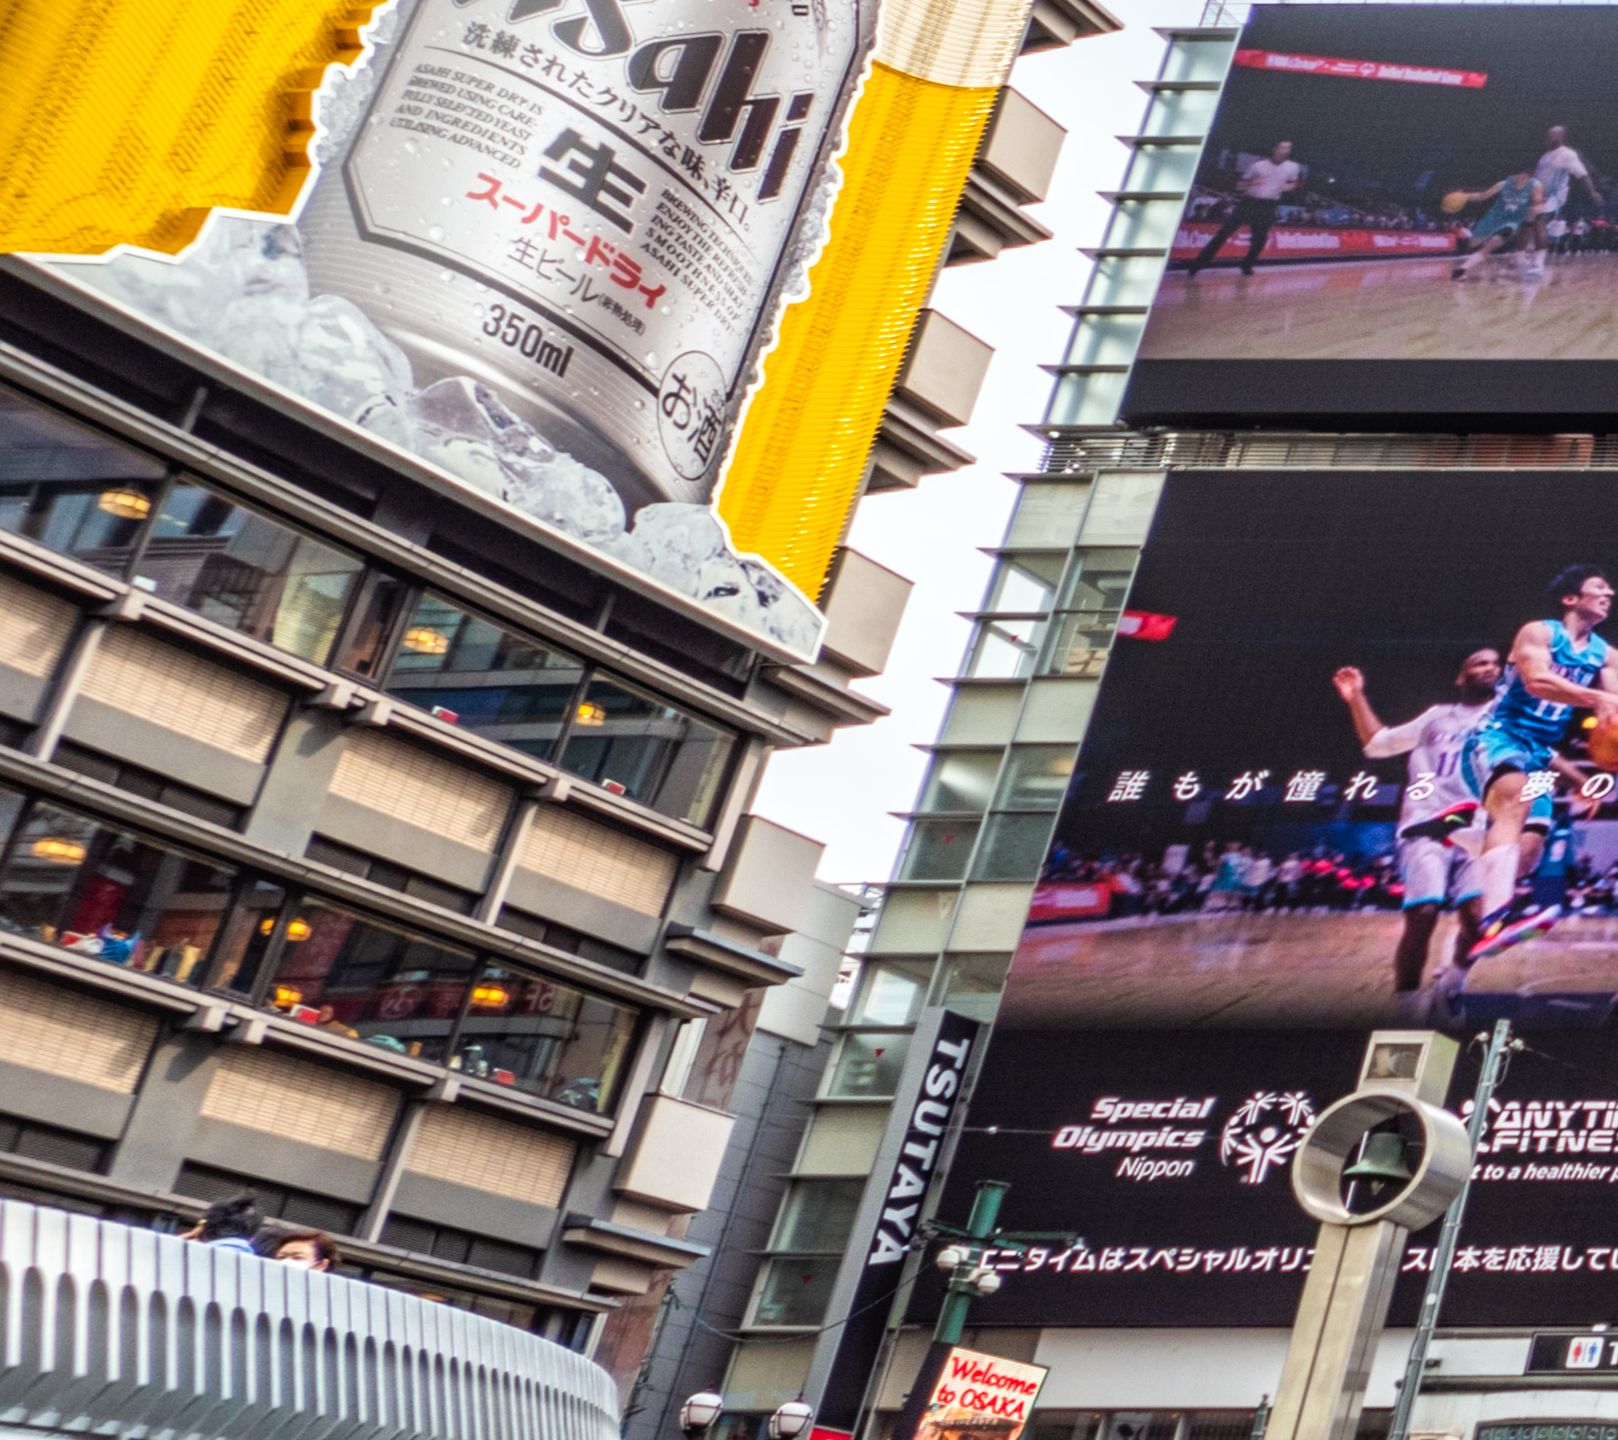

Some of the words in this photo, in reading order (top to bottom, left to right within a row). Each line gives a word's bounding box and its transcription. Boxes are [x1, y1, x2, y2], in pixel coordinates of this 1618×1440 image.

[538, 127, 648, 240] 生
[466, 172, 667, 309] スーパードライ
[482, 304, 575, 378] 350ml
[1108, 770, 1434, 801] 誰もが憧れる
[1090, 1096, 1218, 1123] Special
[869, 1038, 970, 1265] TSUTAYA
[1053, 1126, 1206, 1153] Olympics
[1116, 1156, 1193, 1180] Nippon
[1523, 1162, 1605, 1180] healthier
[951, 1356, 1037, 1396] Welcome
[937, 1385, 956, 1405] to
[960, 1388, 1025, 1420] OSAKA
